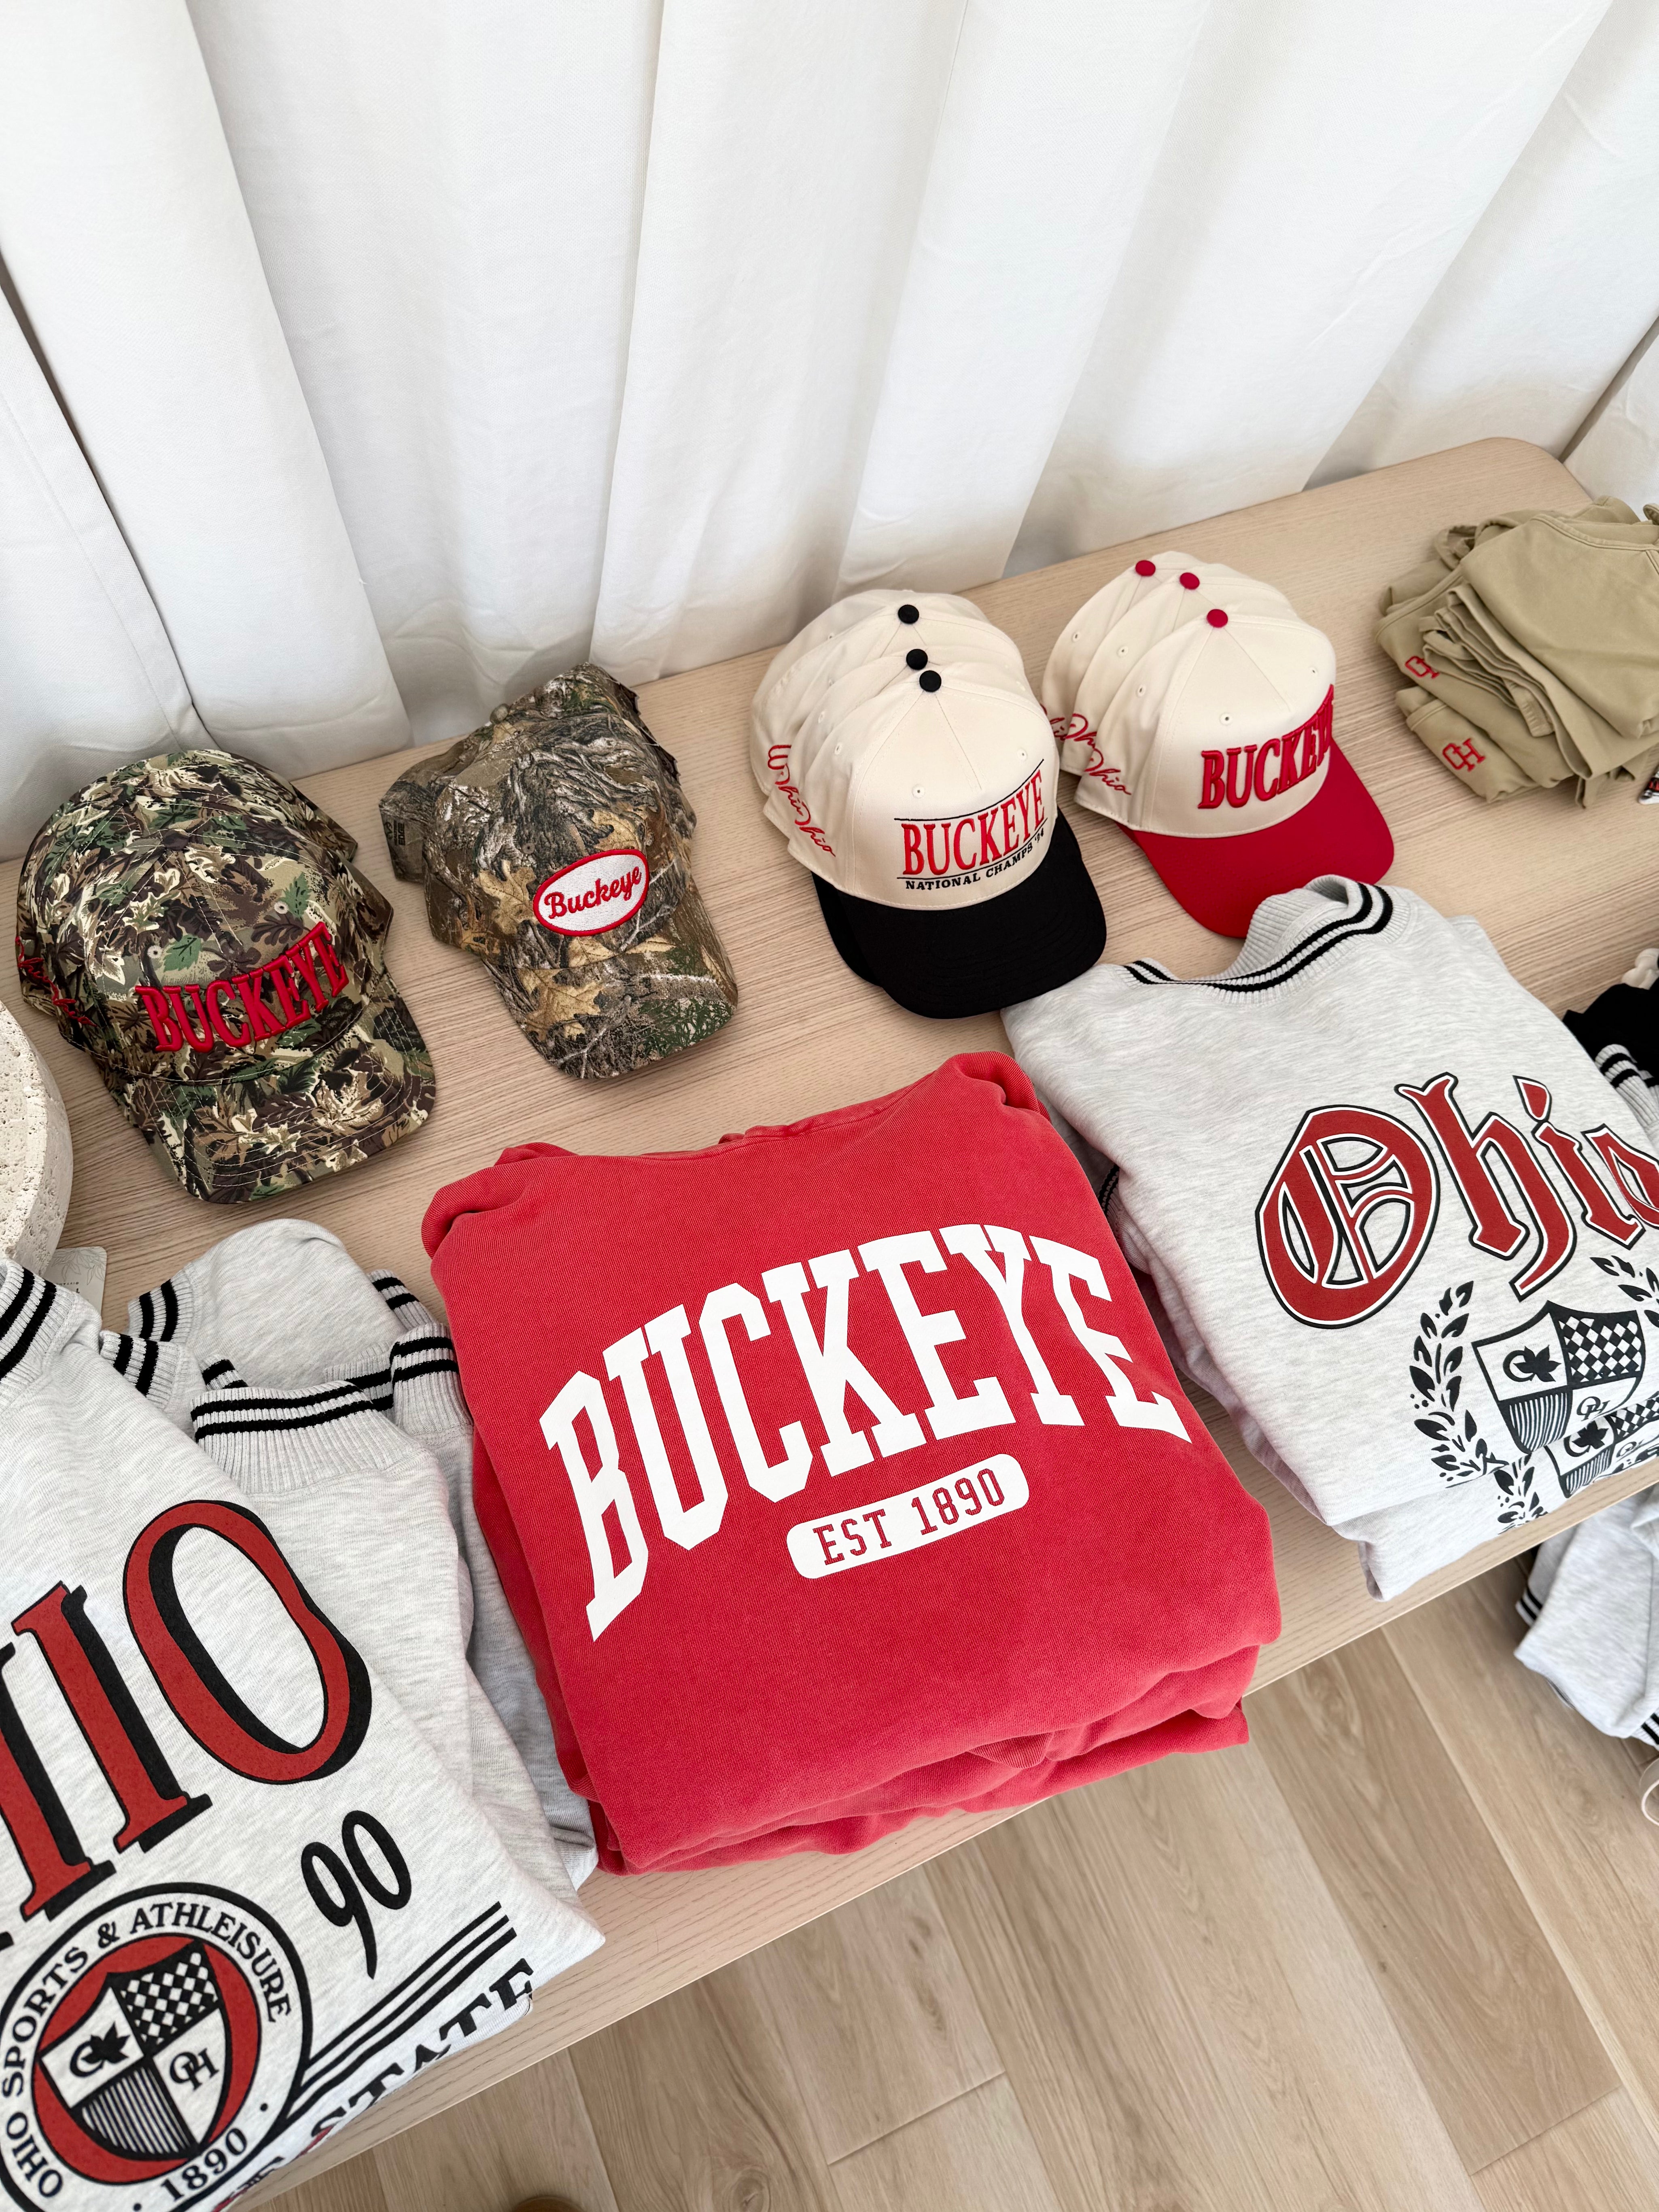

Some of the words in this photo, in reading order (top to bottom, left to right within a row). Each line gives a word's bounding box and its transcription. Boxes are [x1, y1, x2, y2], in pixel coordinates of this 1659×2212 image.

[901, 770, 1045, 875] BUCKEYE
[906, 872, 981, 890] NATIONAL
[985, 841, 1033, 879] CHAMPS
[544, 866, 642, 919] Buckeye
[135, 921, 350, 1052] BUCKEYE
[539, 1224, 1192, 1642] BUCKEYE
[813, 1509, 892, 1565] EST
[911, 1468, 1005, 1535] 1890
[0, 1499, 373, 1951] IO
[97, 1921, 121, 1949] &
[300, 1810, 412, 1981] 90
[129, 1902, 292, 2023] ATHLEISURE
[2, 1946, 89, 2098] SPORTS
[6, 2111, 64, 2198] OHIO
[161, 2127, 249, 2201] 1890
